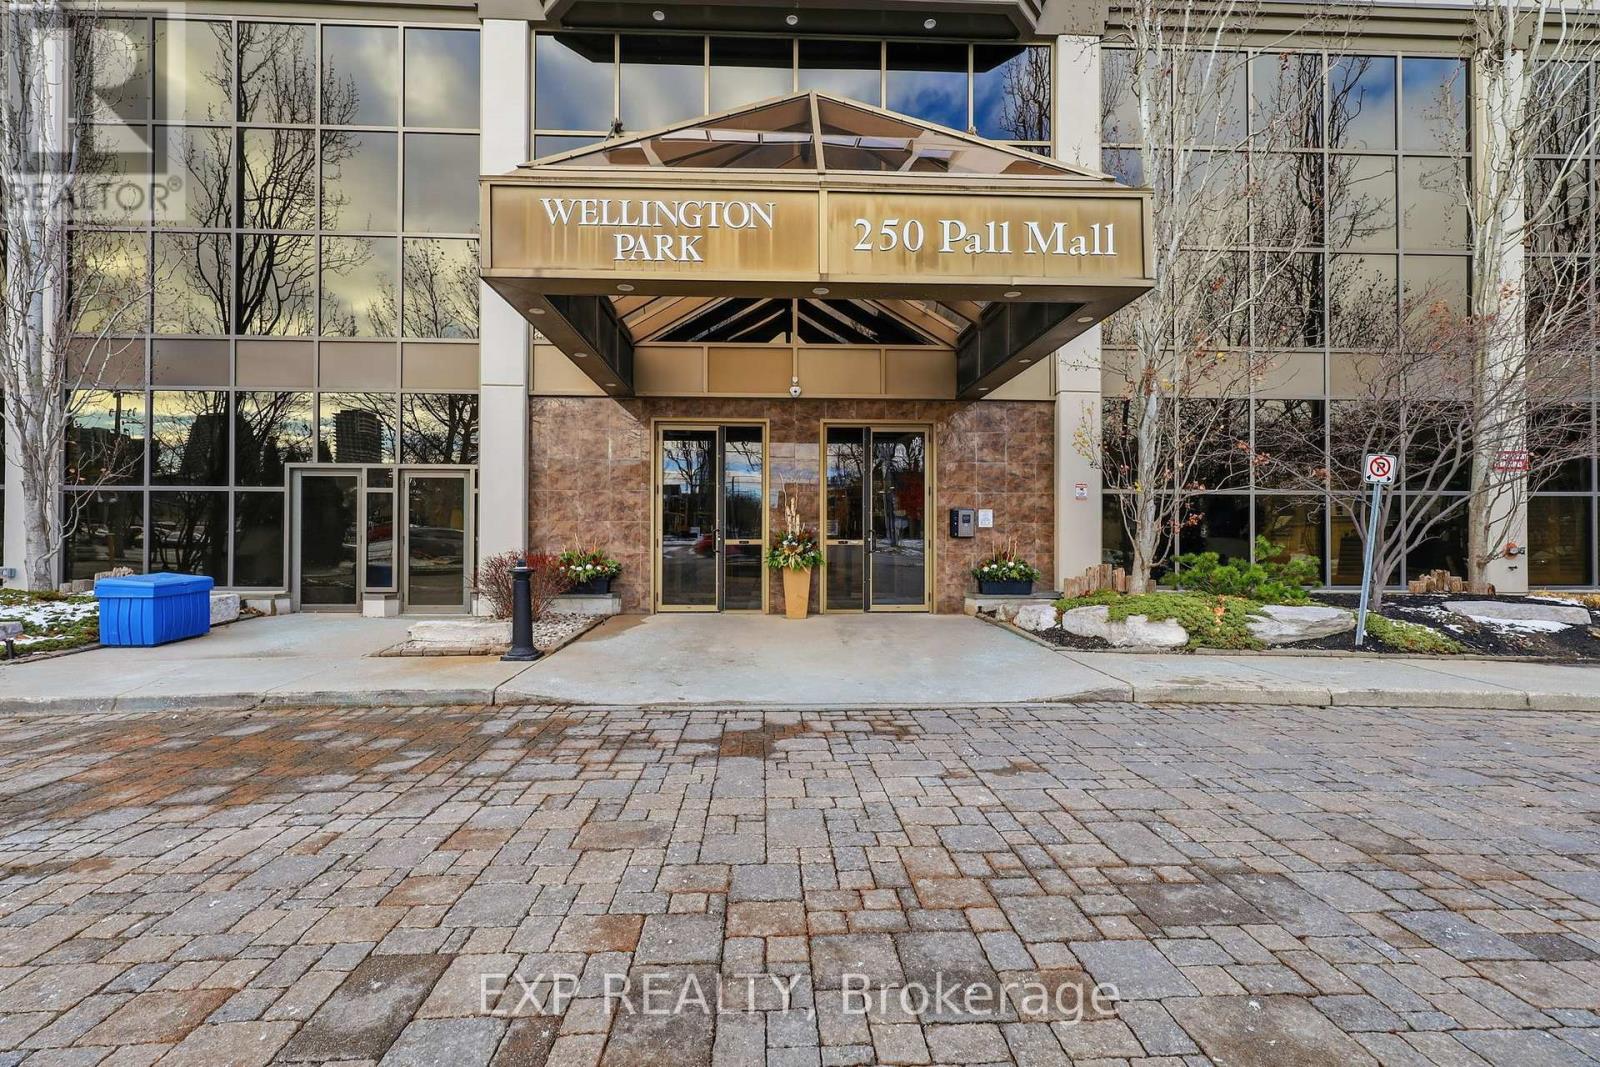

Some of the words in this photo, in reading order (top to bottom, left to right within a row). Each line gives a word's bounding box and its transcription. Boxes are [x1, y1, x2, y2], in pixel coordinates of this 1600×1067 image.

[541, 198, 776, 229] WELLINGTON
[613, 233, 704, 262] PARK
[853, 218, 924, 252] 250
[938, 219, 1013, 255] Pall
[1024, 221, 1118, 256] Mall
